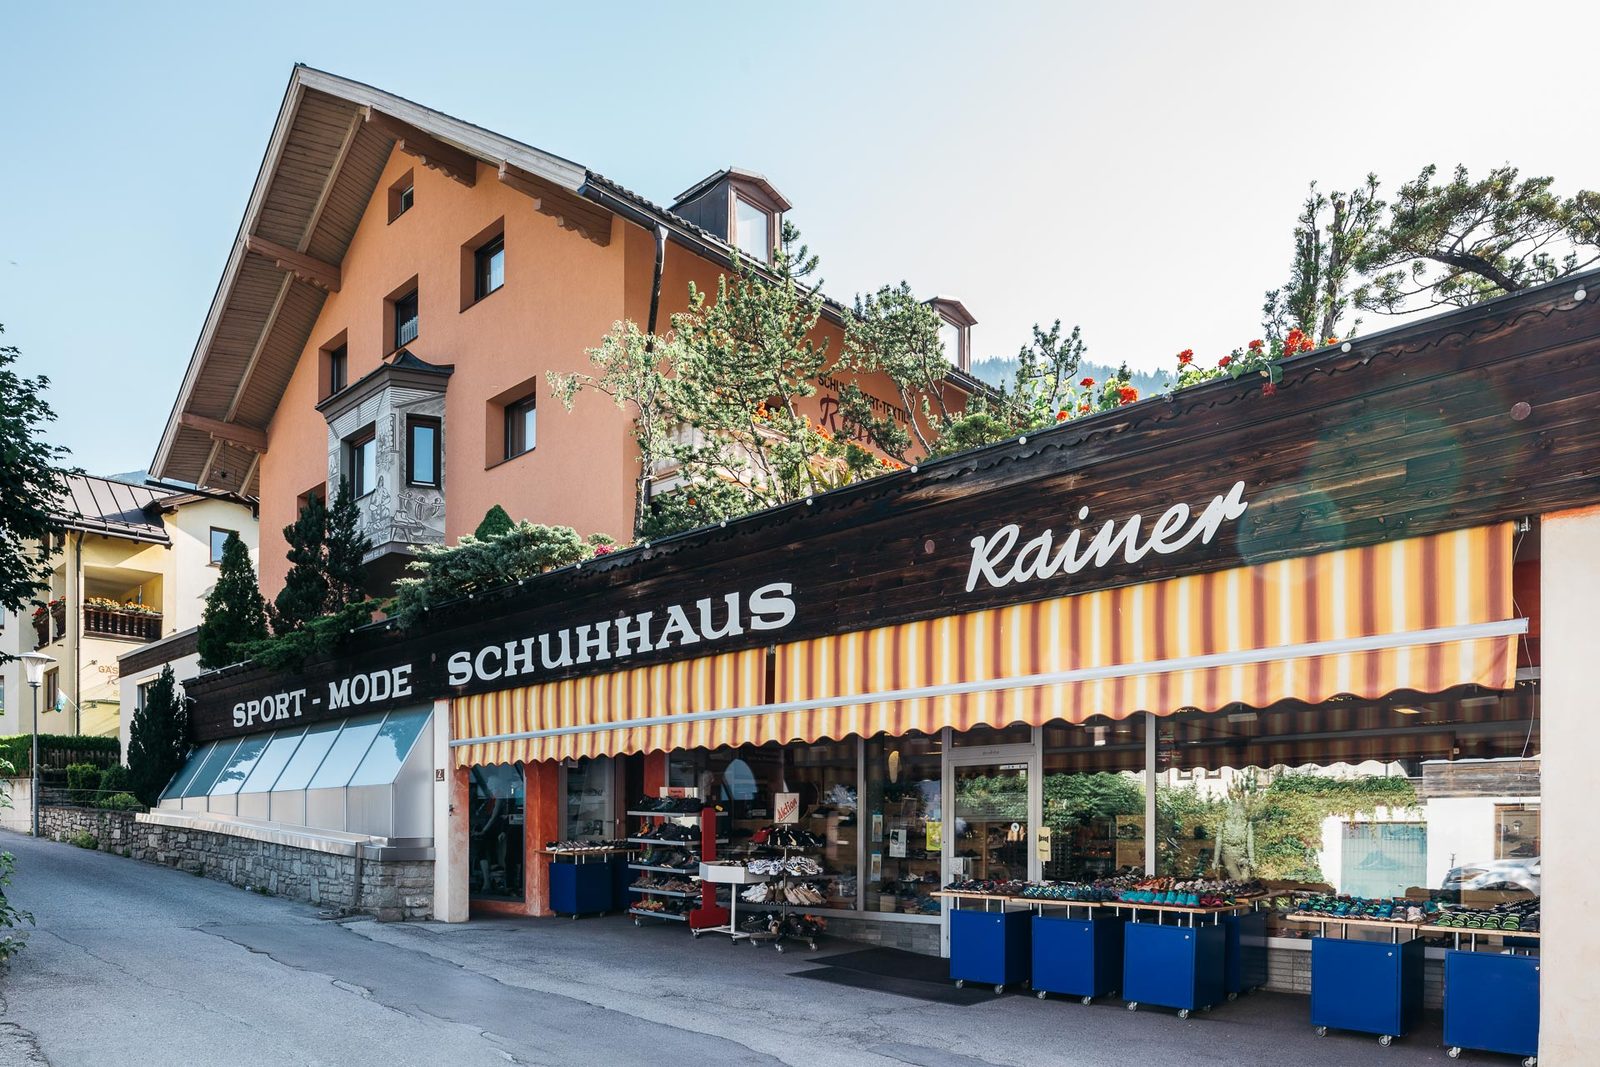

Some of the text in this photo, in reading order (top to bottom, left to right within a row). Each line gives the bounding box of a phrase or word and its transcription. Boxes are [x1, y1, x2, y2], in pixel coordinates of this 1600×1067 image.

[966, 481, 1248, 592] Rainer
[98, 665, 119, 675] GÄS
[447, 582, 796, 686] SCHUHHAUS
[232, 688, 306, 728] SPORT
[328, 664, 412, 710] MODE
